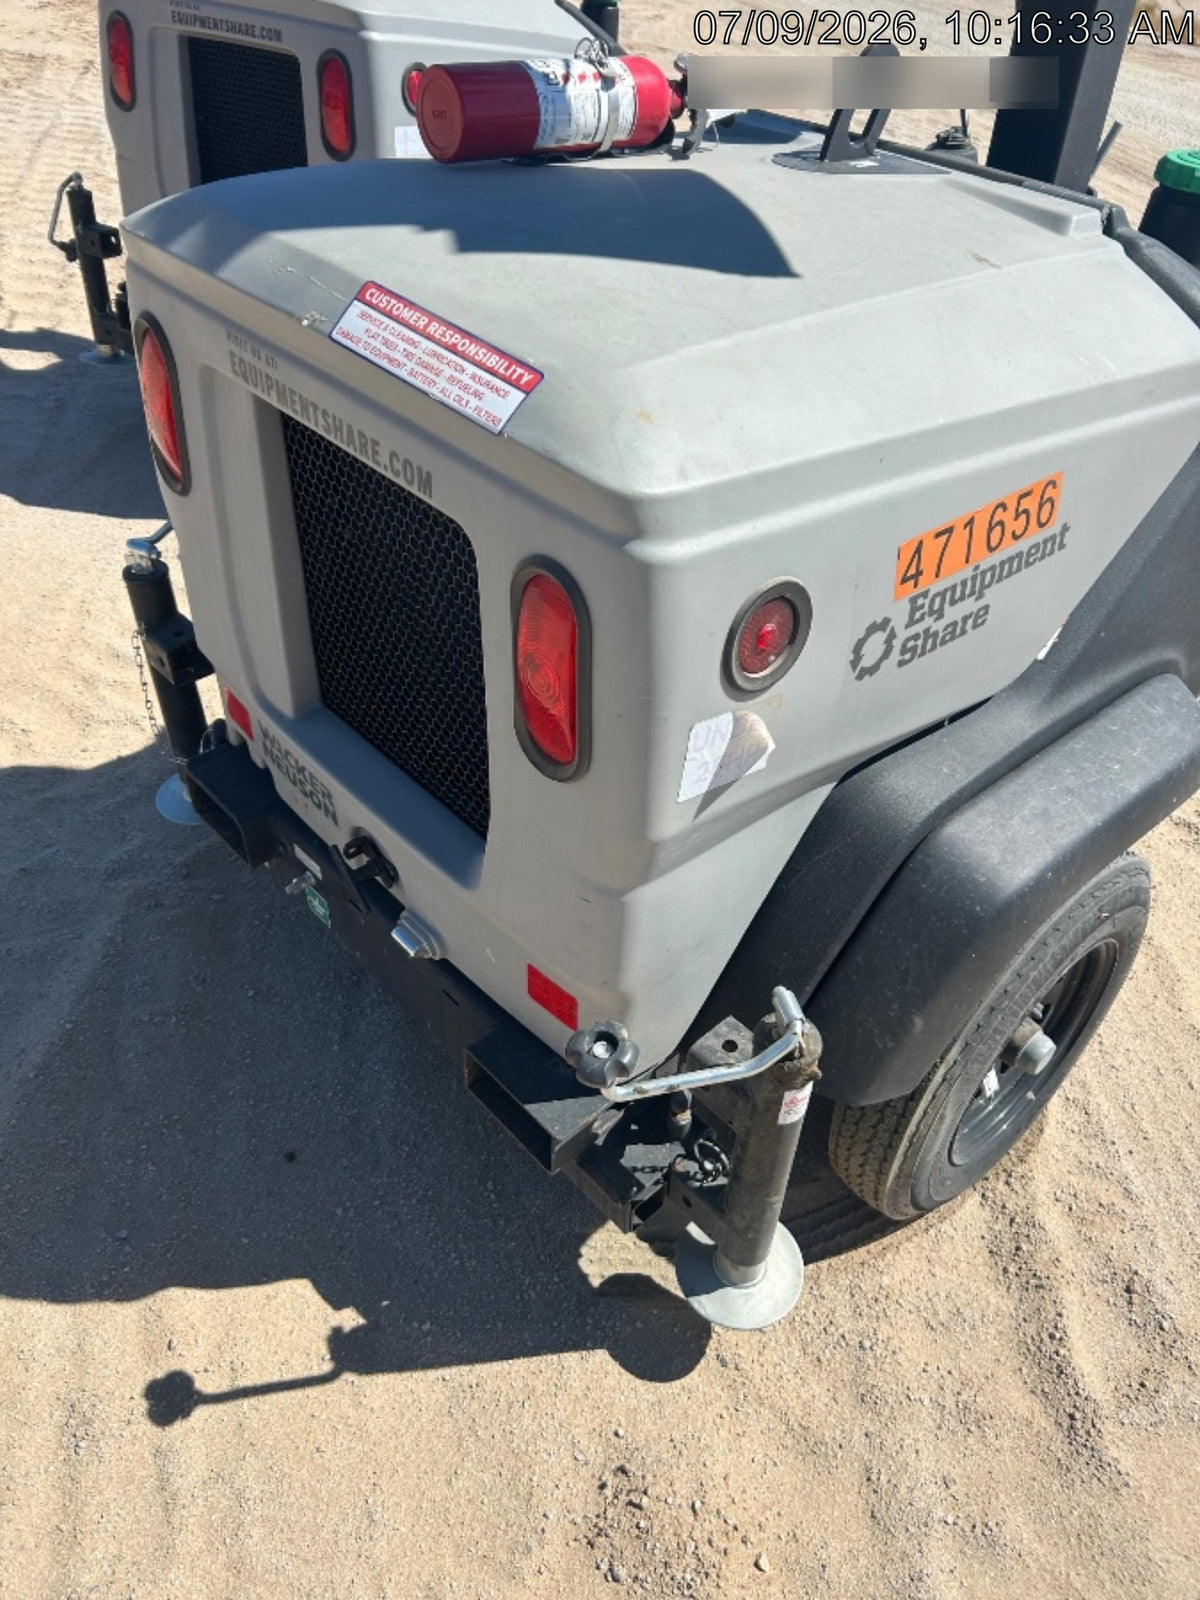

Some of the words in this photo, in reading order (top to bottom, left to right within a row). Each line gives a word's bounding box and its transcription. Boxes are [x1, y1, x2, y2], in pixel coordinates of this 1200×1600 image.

[171, 11, 283, 42] EQUIPMENTSHARE.COM
[335, 326, 362, 347] DAMAGE
[361, 340, 372, 351] TO
[369, 346, 407, 371] EQUIPMENT
[406, 367, 438, 389] BATTERY
[439, 386, 452, 399] ALL
[452, 394, 470, 409] OILS
[472, 404, 503, 428] FILTERS
[356, 308, 385, 329] SERVICE
[386, 325, 421, 349] CLEANING
[421, 345, 467, 375] LUBRICATION
[467, 371, 510, 399] INSURANCE
[364, 327, 381, 341] FLAT
[379, 335, 399, 351] TIRES
[415, 357, 444, 377] DAMAGE
[446, 374, 485, 401] REFUELING
[365, 288, 428, 330] CUSTOMER
[426, 321, 535, 385] RESPONSIBILITY
[229, 349, 433, 499] EQUIPMENTSHARE.COM
[899, 479, 1058, 589] 471656
[904, 522, 1071, 630] Equipment
[896, 604, 991, 668] Share
[257, 719, 334, 809] WACKER
[262, 740, 338, 827] NEUSON
